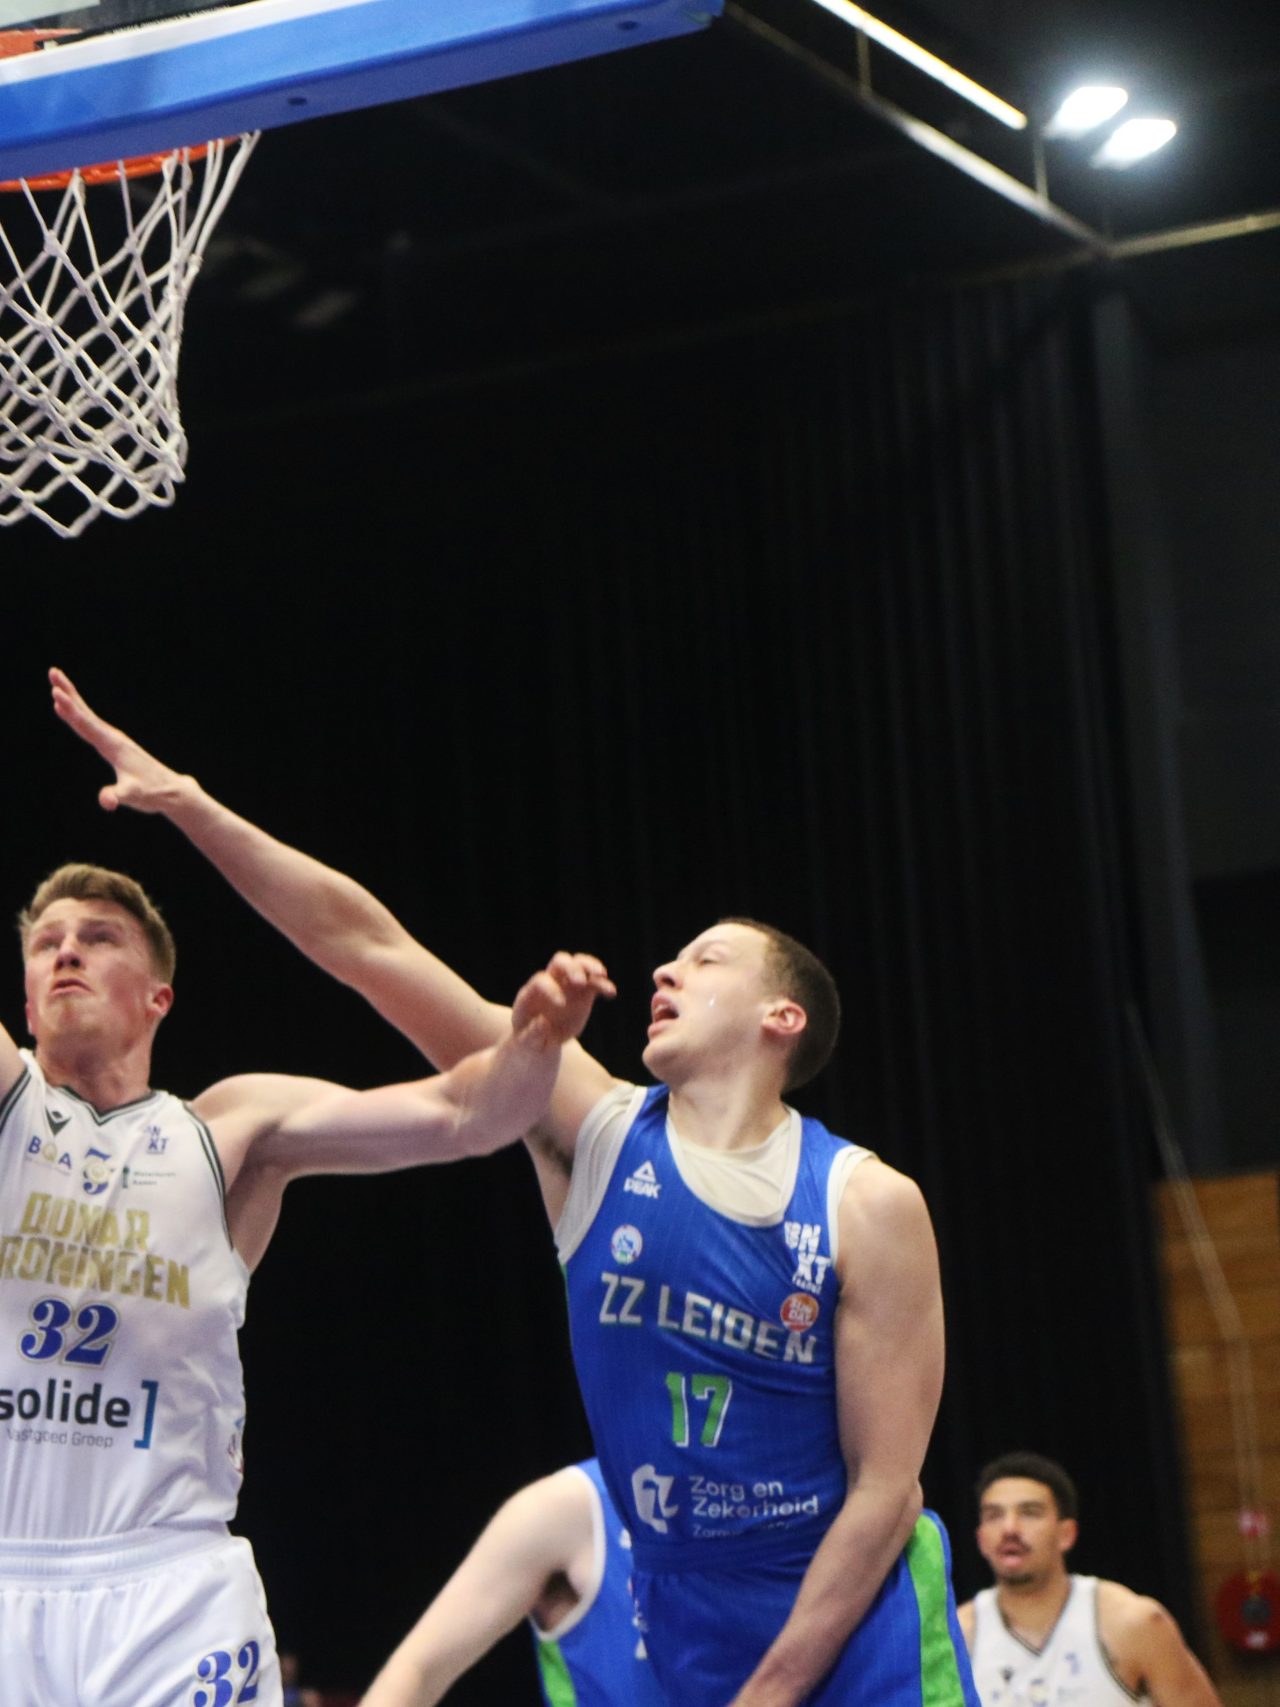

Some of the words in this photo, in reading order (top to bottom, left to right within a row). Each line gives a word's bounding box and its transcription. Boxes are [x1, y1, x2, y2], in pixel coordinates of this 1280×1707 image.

[623, 1177, 662, 1199] PEAK
[21, 1191, 150, 1250] DONAR
[18, 1296, 120, 1369] 32
[599, 1271, 646, 1324] ZZ
[657, 1284, 817, 1363] LEIDEN
[665, 1371, 733, 1448] 17
[688, 1475, 745, 1503] Zorg
[752, 1480, 783, 1499] en
[692, 1494, 819, 1520] Zekerheid
[193, 1640, 260, 1707] 32
